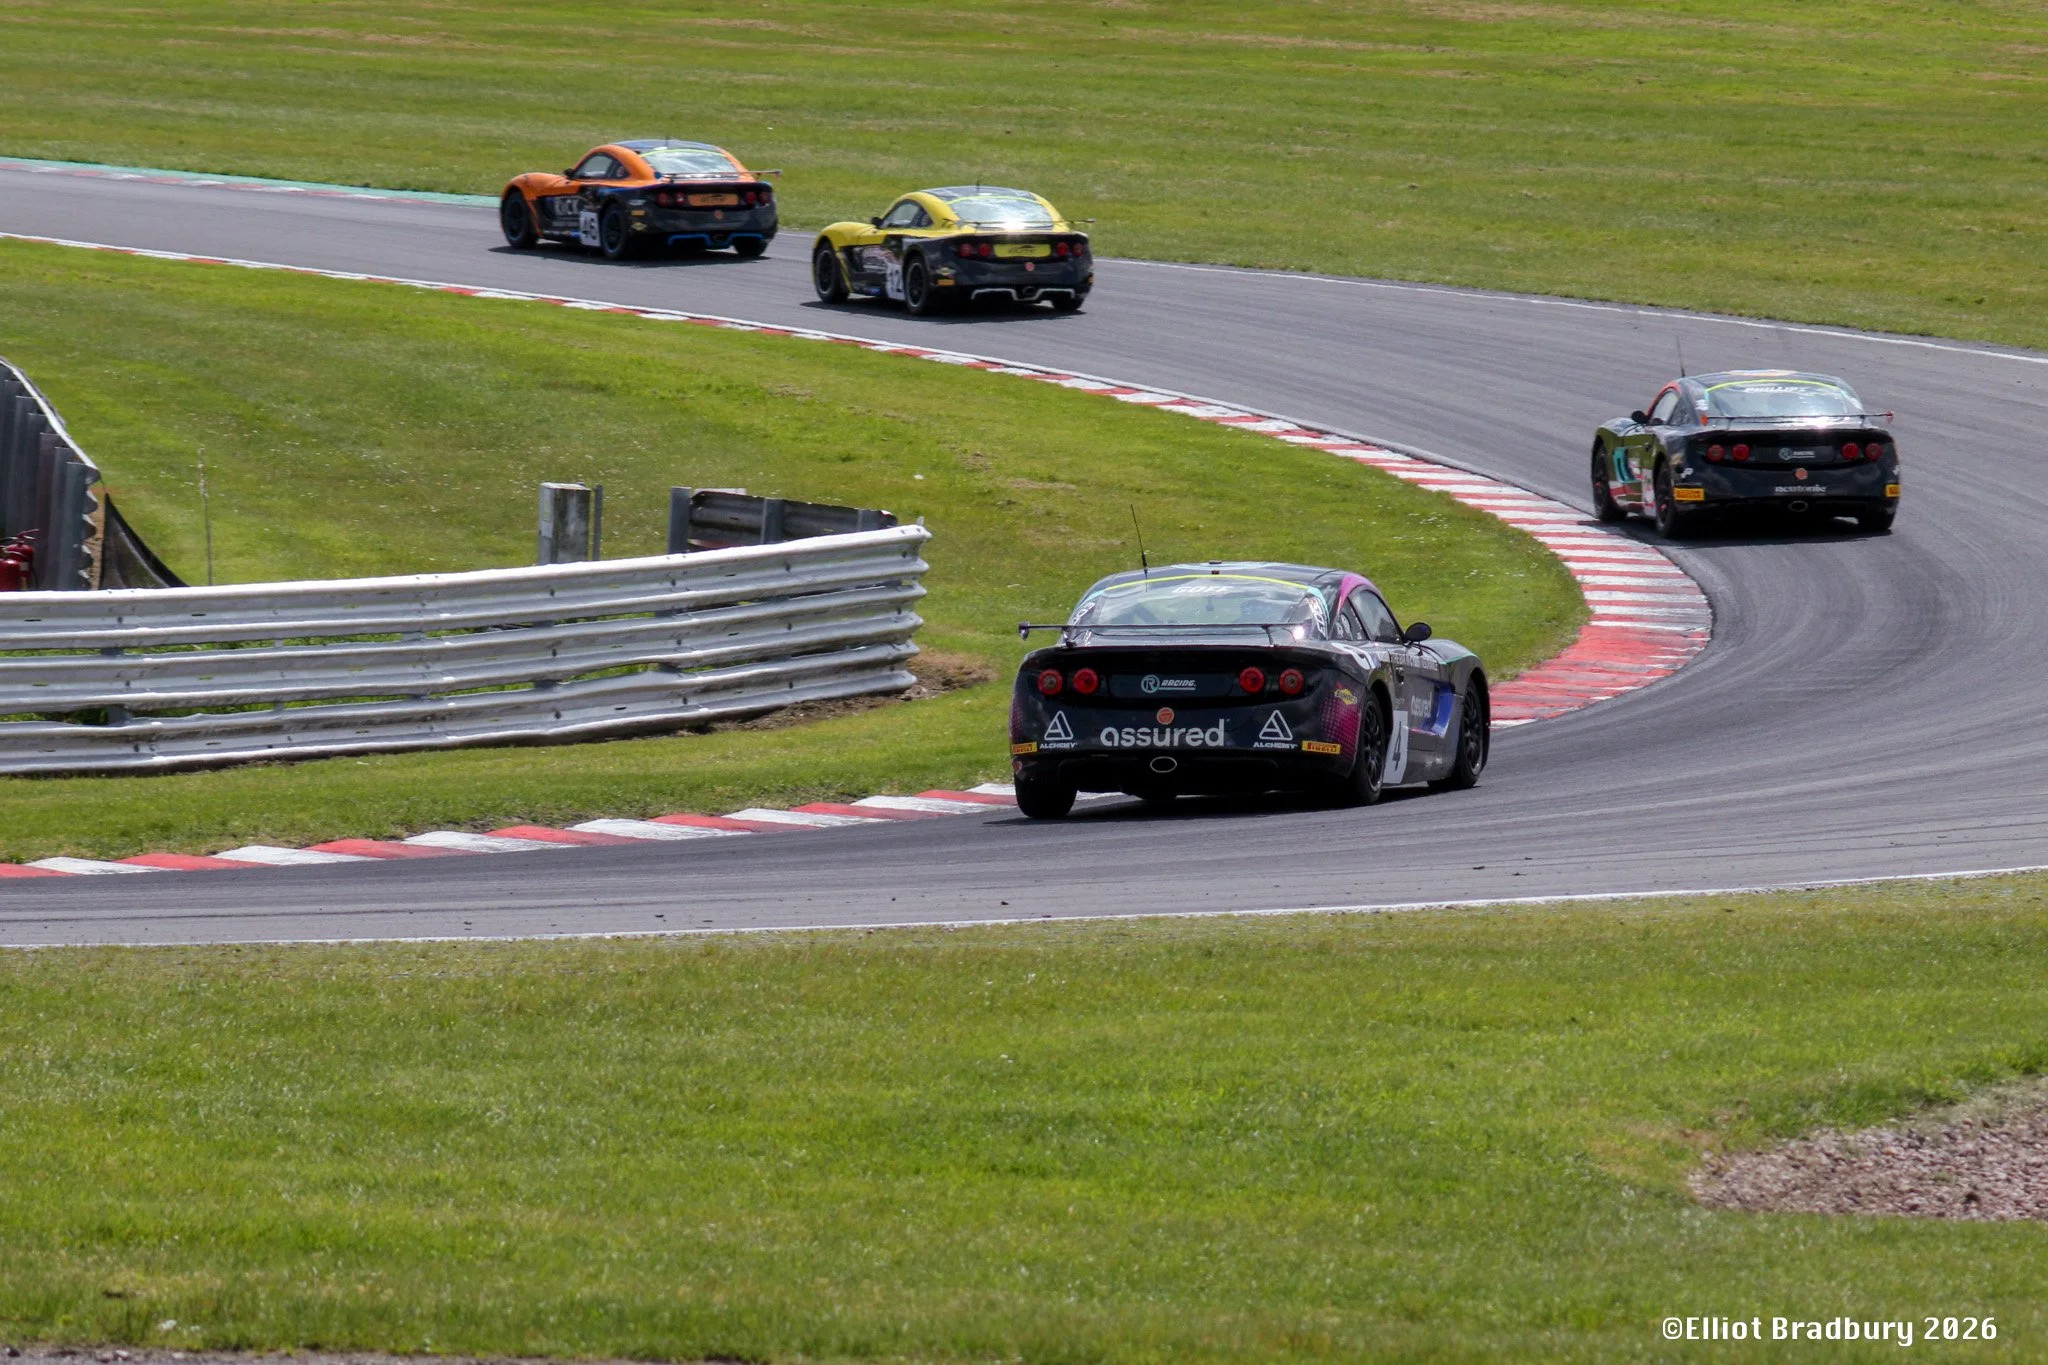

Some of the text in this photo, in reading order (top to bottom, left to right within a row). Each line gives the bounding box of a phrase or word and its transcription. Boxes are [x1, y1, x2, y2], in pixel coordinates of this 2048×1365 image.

[1100, 718, 1224, 748] assured
[1039, 742, 1076, 750] ALCHEMY
[1253, 741, 1295, 750] ALCHEMY
[1392, 720, 1402, 772] 4
